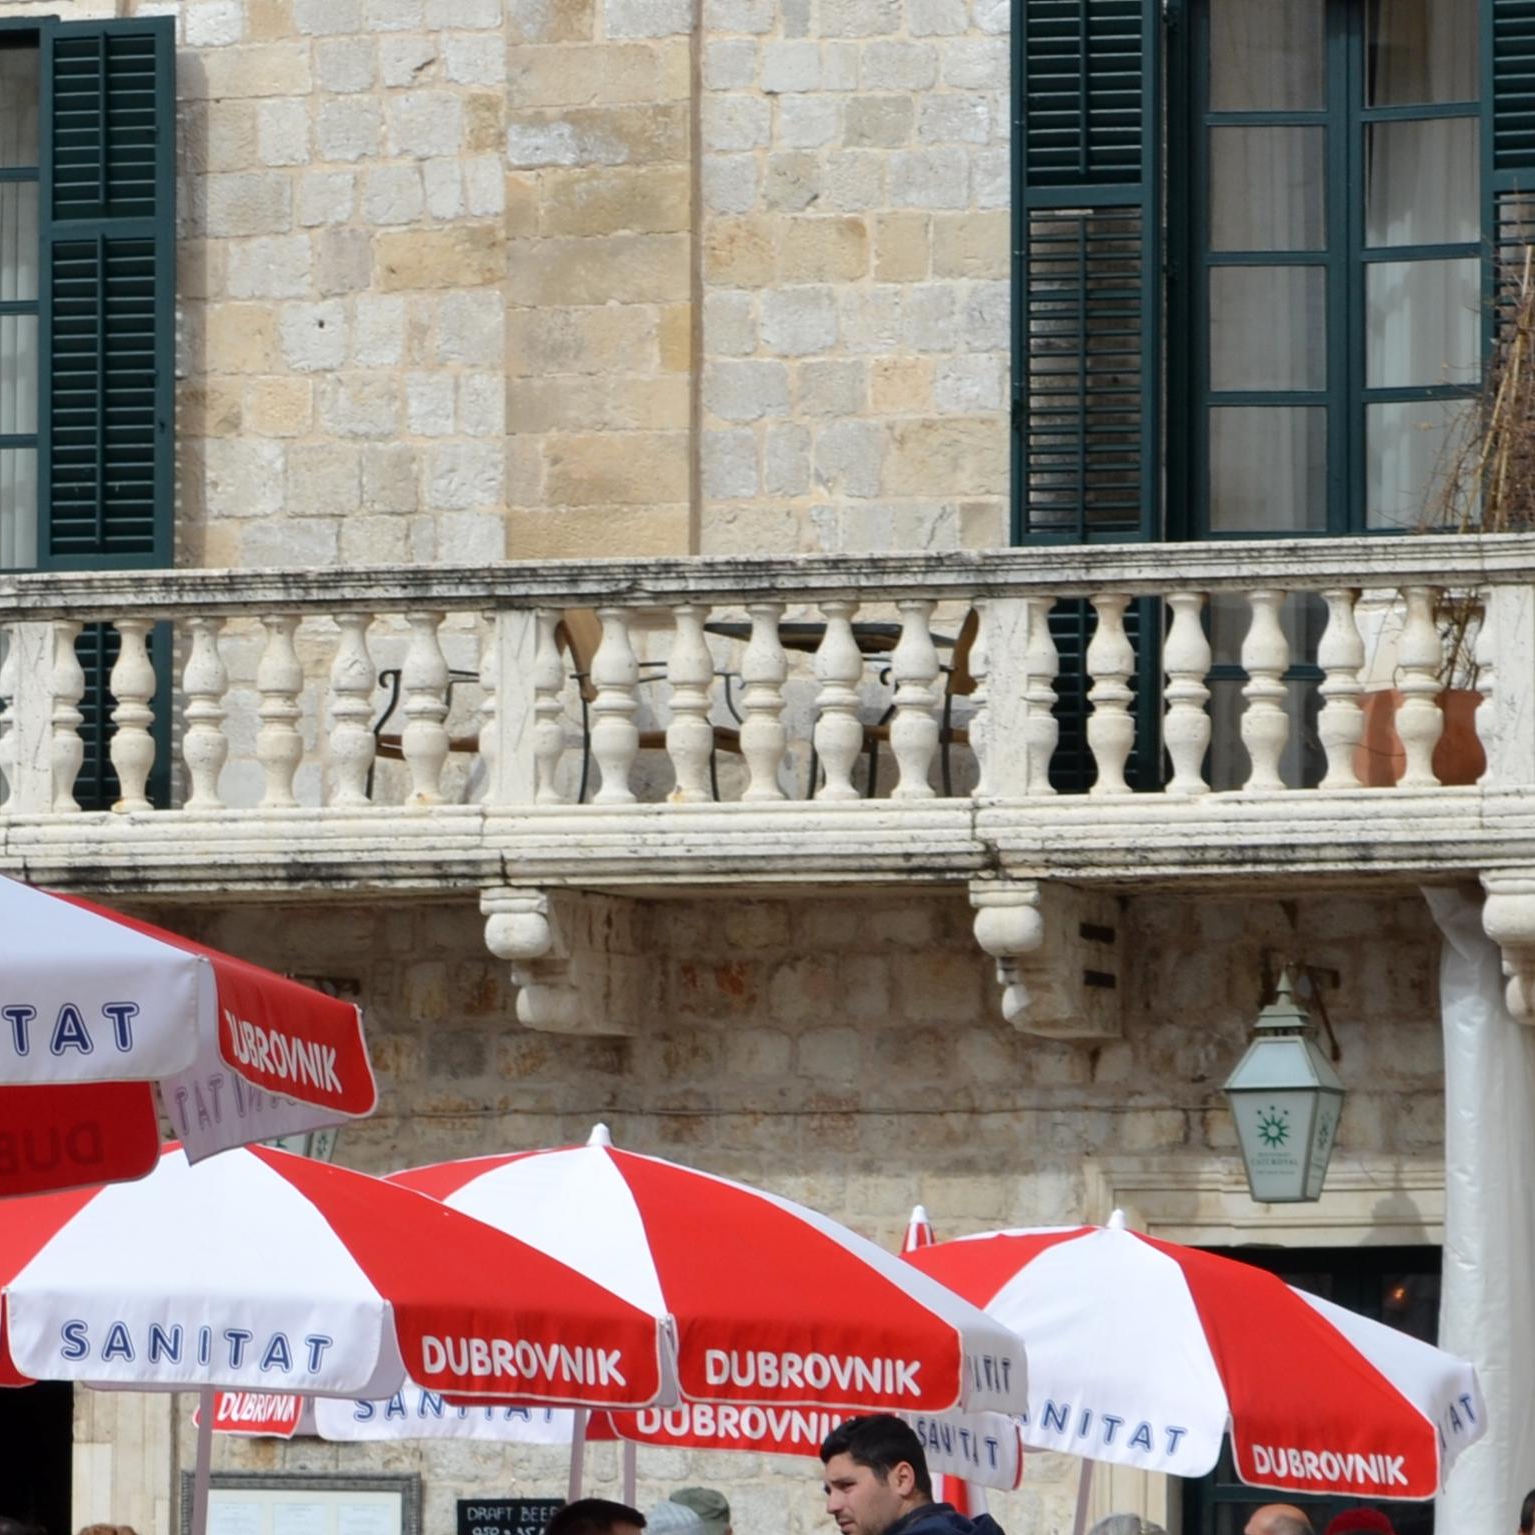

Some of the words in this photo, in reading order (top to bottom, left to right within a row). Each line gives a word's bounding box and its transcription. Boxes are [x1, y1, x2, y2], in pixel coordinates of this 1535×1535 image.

[60, 1319, 334, 1374] SANITAT
[422, 1335, 627, 1387] DUBROVNIK
[705, 1349, 922, 1397] DUBROVNIK
[1251, 1443, 1409, 1487] DUBROVNIK
[467, 1506, 513, 1522] DRAFT
